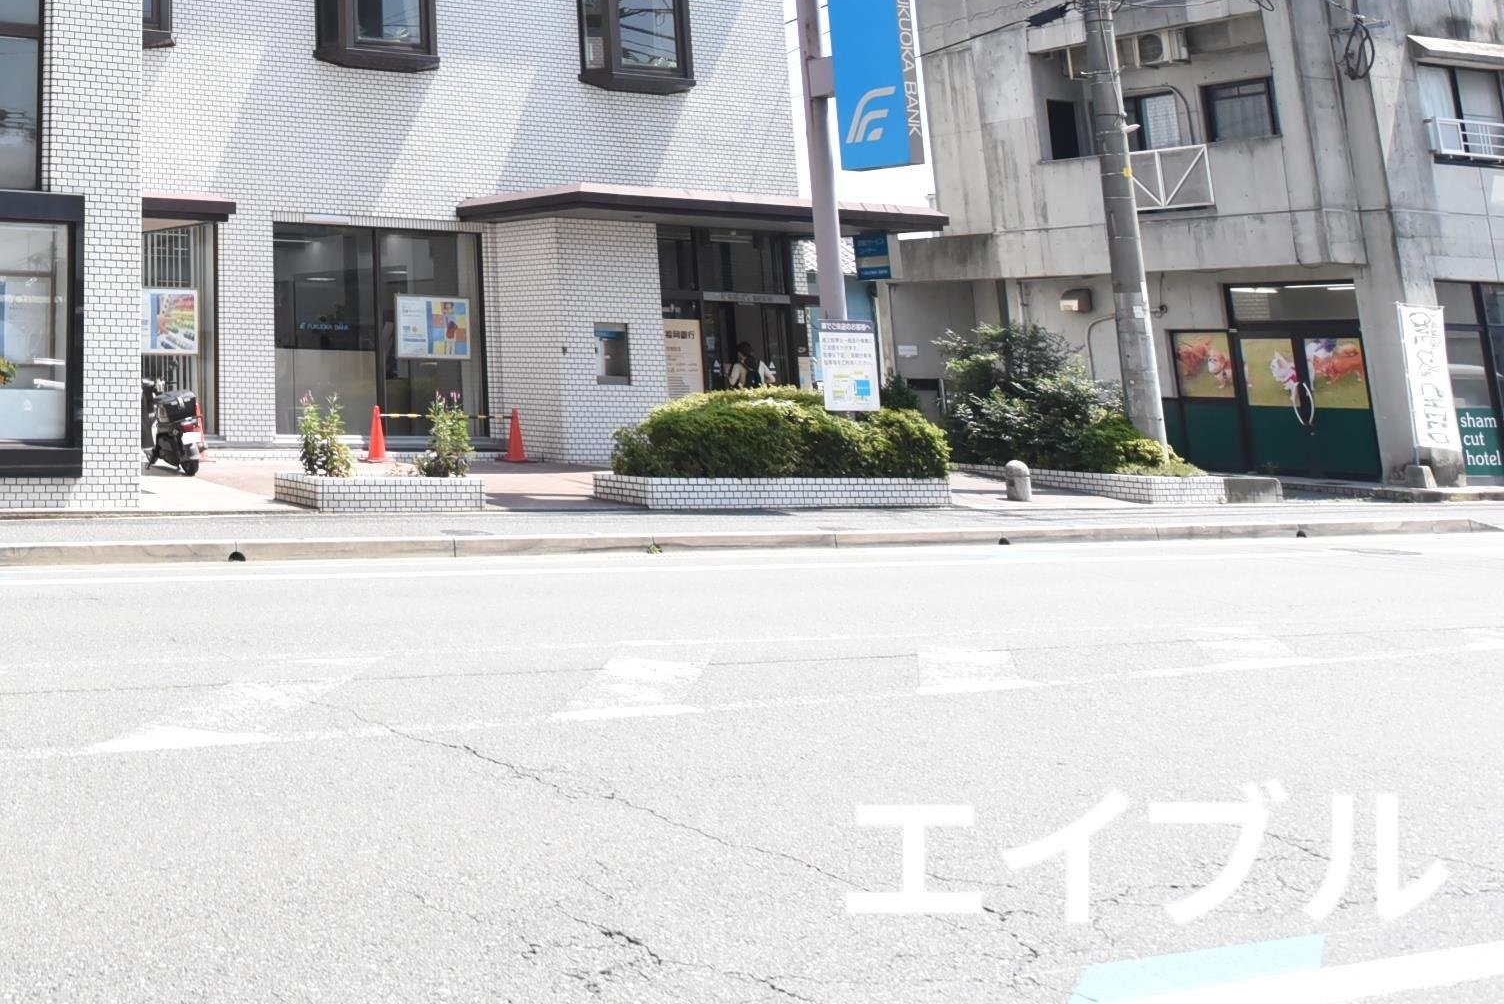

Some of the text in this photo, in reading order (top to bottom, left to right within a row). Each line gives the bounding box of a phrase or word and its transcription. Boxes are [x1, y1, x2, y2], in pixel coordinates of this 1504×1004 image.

[903, 81, 922, 137] BANK
[1460, 412, 1497, 428] sham
[1463, 433, 1485, 446] cut
[1466, 450, 1502, 466] hotel
